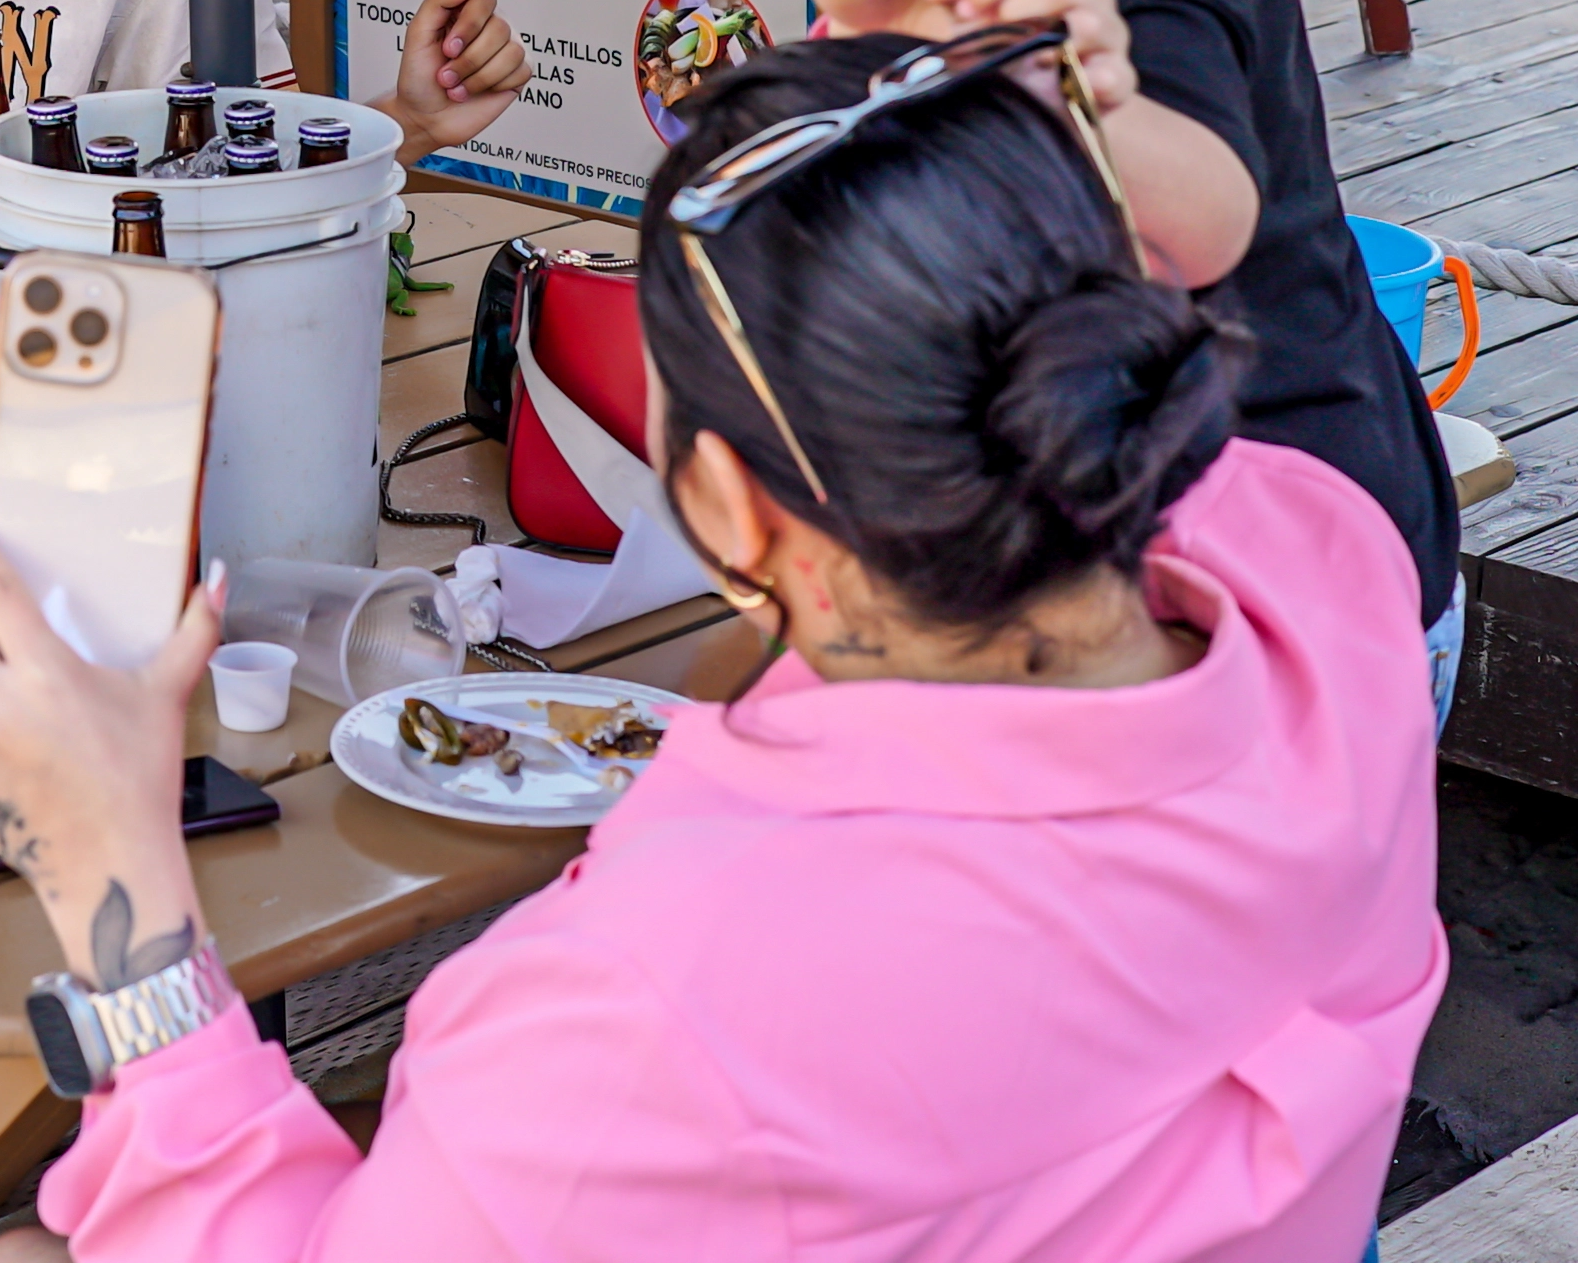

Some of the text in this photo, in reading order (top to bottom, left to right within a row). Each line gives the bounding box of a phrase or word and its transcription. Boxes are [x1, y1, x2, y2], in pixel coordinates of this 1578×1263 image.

[357, 2, 622, 67] TODOS PLATILLOS
[525, 151, 594, 177] NUESTROS
[596, 167, 653, 189] PRECIOS
